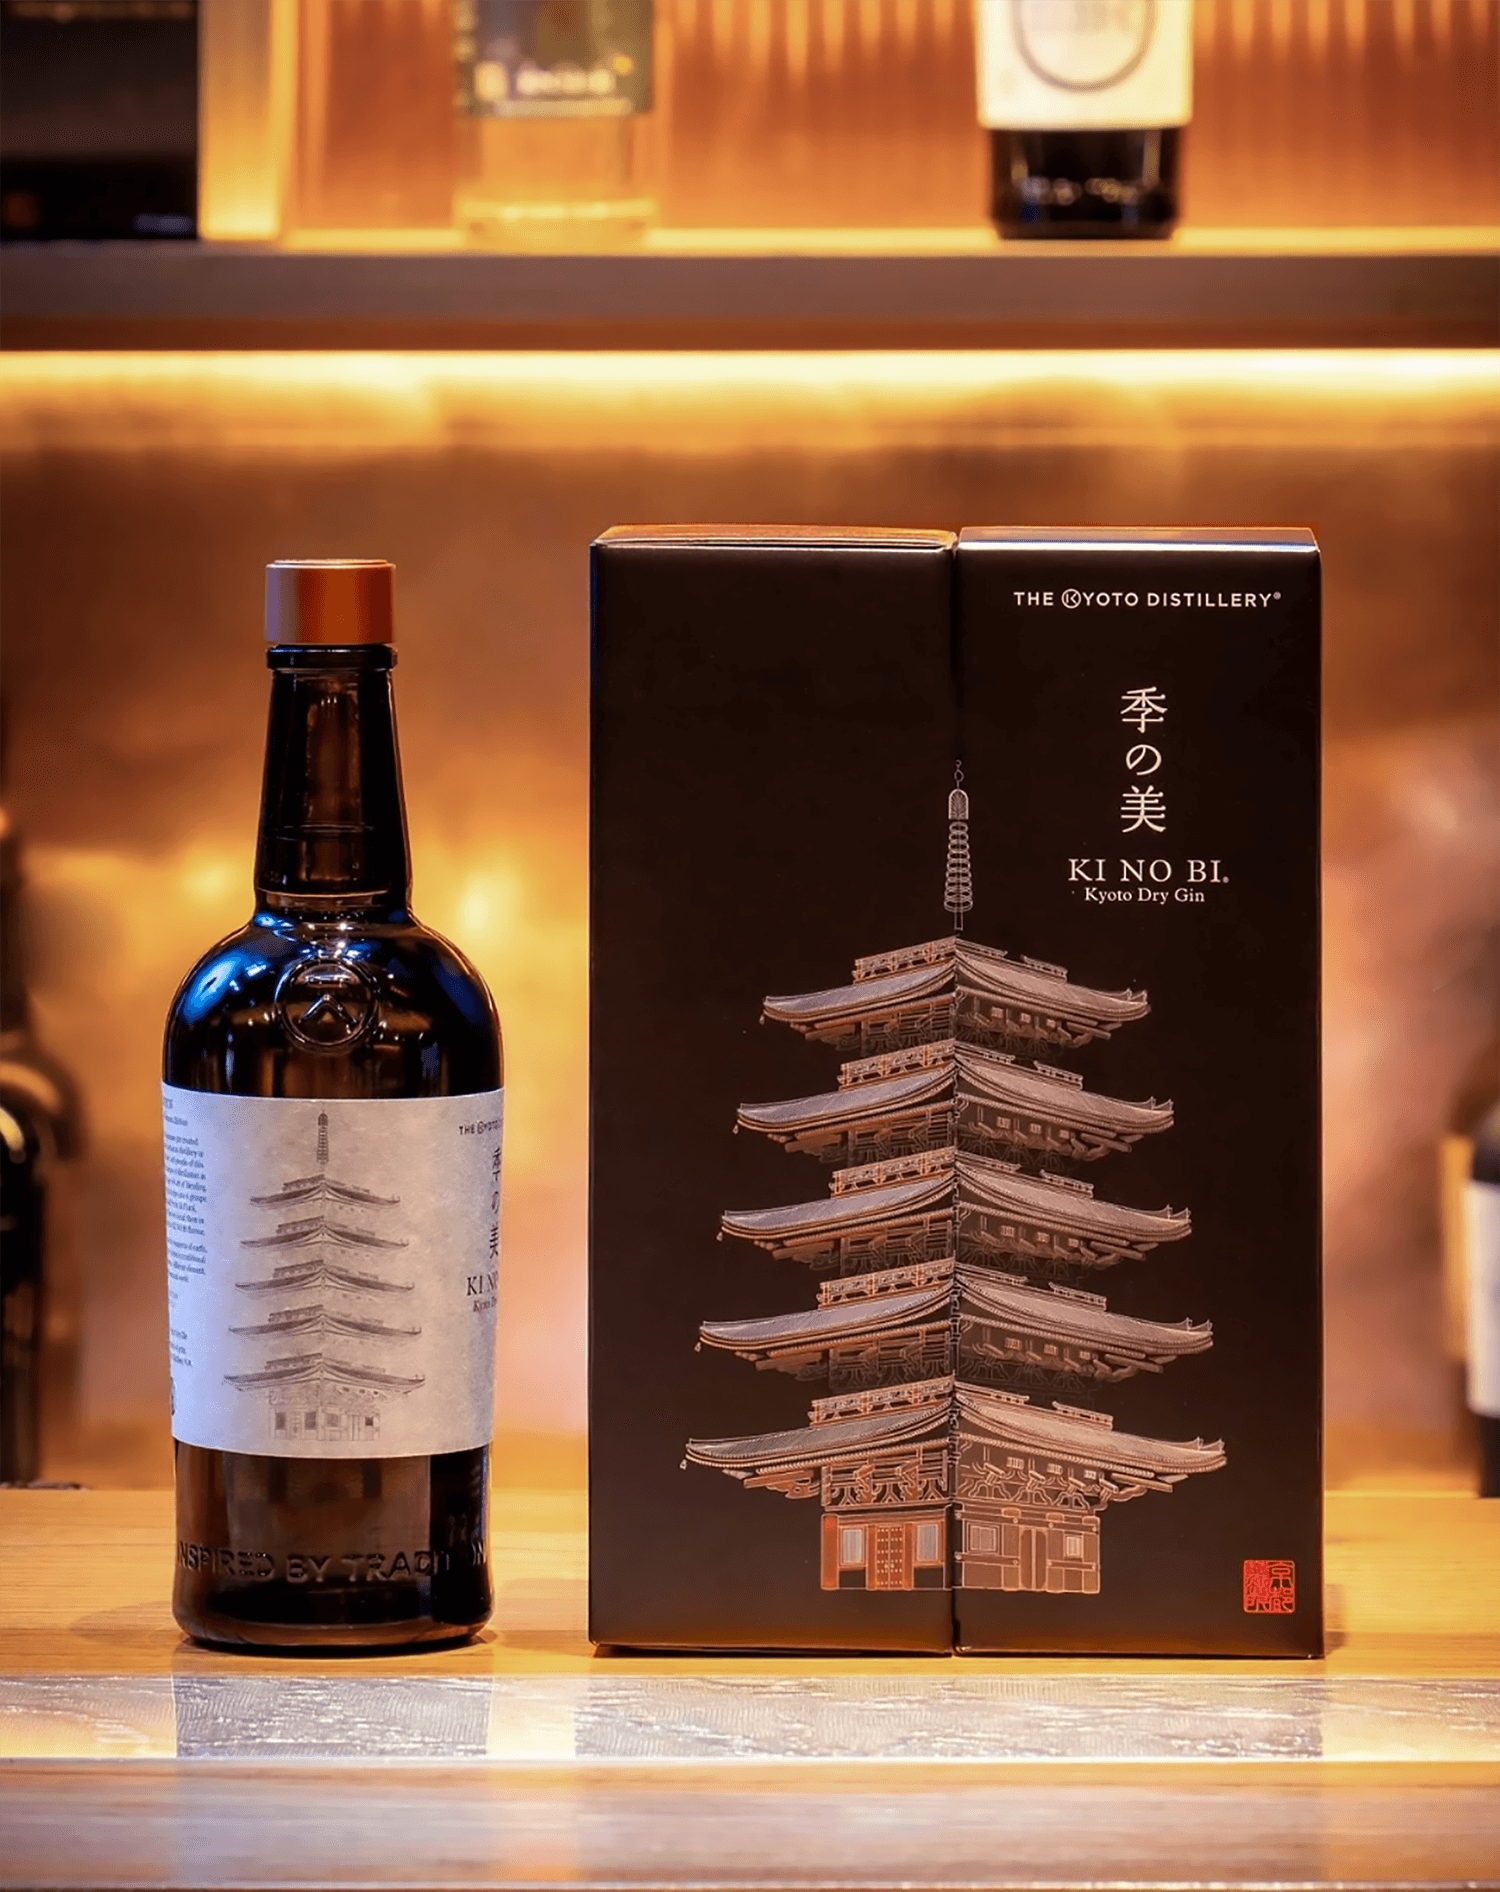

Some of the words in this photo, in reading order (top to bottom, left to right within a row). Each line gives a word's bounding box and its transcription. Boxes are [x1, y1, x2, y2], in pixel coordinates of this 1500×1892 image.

[1013, 591, 1054, 606] THE
[1120, 686, 1168, 833] 季の美
[1068, 858, 1106, 882] KI
[1119, 859, 1172, 883] NO
[1084, 886, 1133, 905] Kyoto
[1137, 886, 1169, 906] Dry
[1174, 886, 1205, 903] Gin
[458, 1123, 475, 1135] THE
[467, 1274, 483, 1296] KI
[285, 1553, 332, 1583] BY
